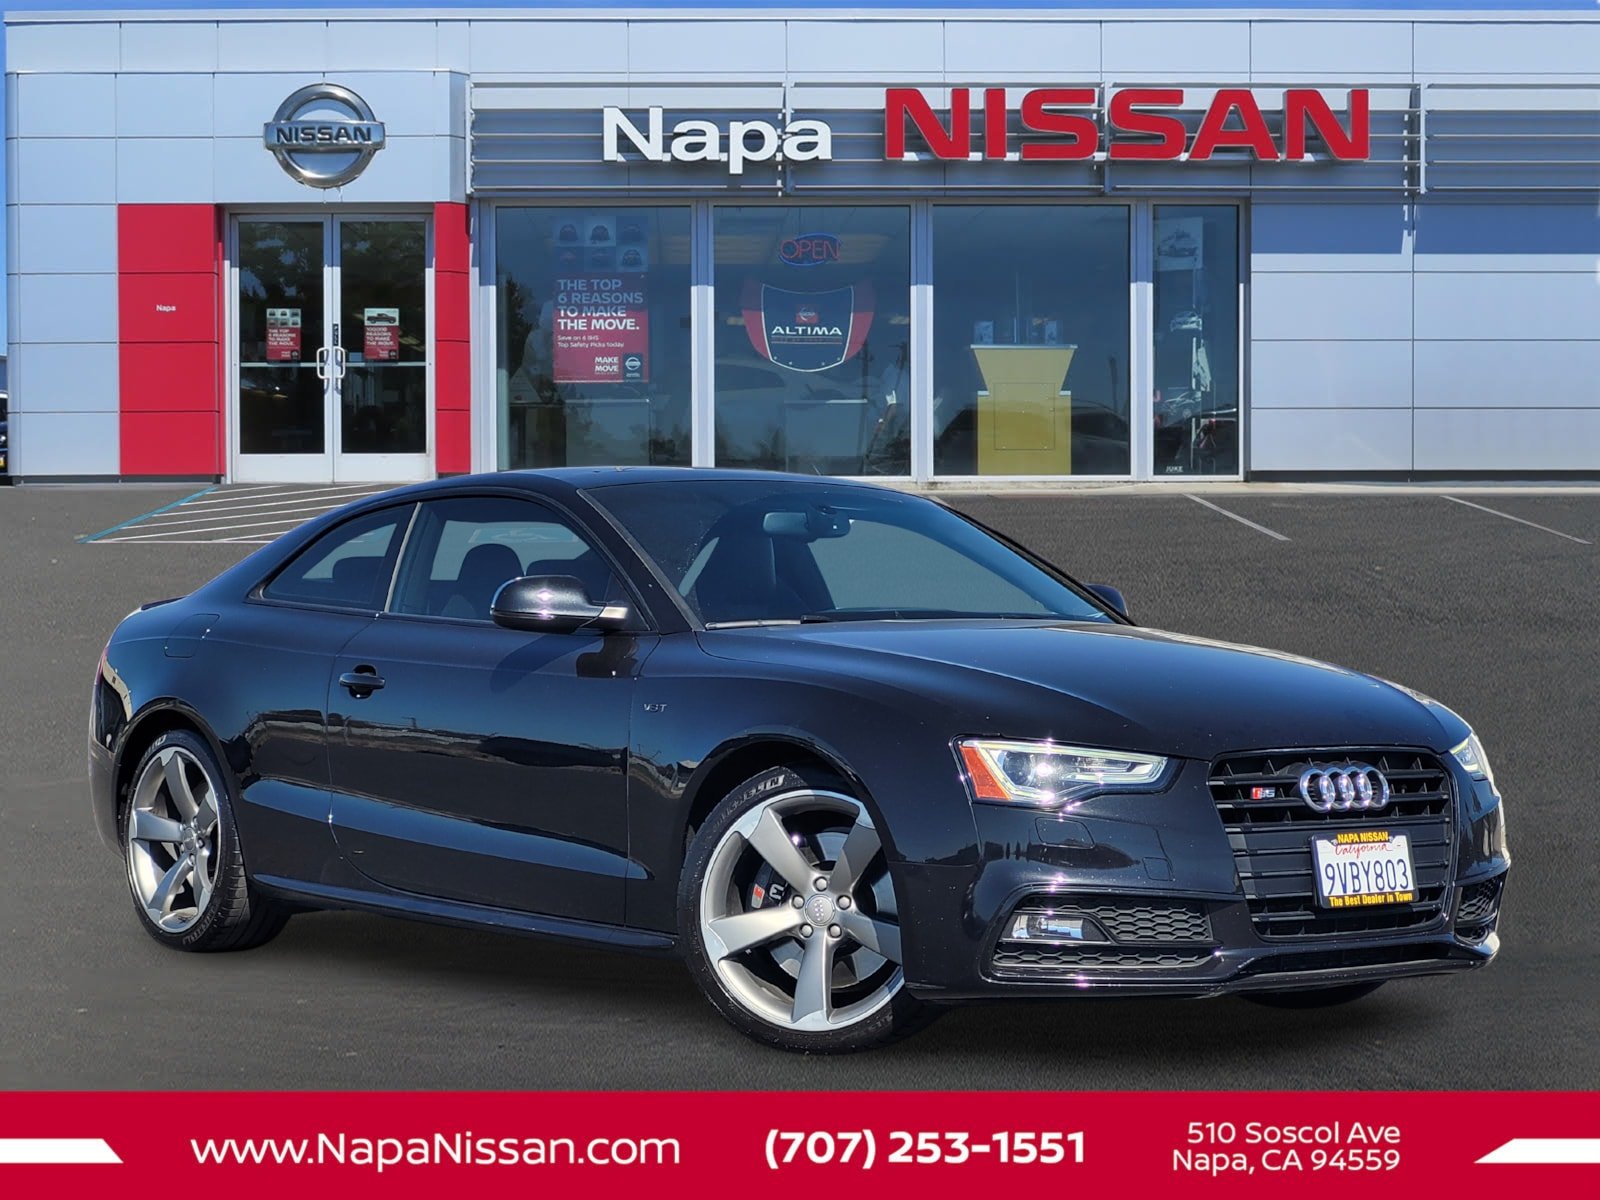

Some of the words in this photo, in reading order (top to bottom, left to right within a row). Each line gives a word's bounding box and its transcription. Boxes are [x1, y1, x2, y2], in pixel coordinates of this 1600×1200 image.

[276, 126, 372, 143] NISSAN
[603, 106, 833, 174] Napa
[885, 87, 1371, 161] NISSAN
[780, 238, 840, 260] OPEN
[557, 279, 587, 291] THE
[591, 279, 622, 291] TOP
[558, 292, 567, 304] 6
[571, 292, 644, 304] REASONS
[156, 304, 176, 312] Napa
[557, 305, 578, 317] TO
[582, 305, 627, 317] MAKE
[557, 318, 587, 331] THE
[591, 318, 640, 331] MOVE.
[771, 326, 842, 335] ALTIMA
[570, 341, 589, 349] Safety
[595, 356, 619, 364] MAKE
[595, 365, 619, 373] MOVE
[1337, 833, 1358, 844] NAPA
[1360, 831, 1389, 842] NISSAN
[1335, 843, 1393, 859] California
[1324, 858, 1408, 896] 9VBY803
[1329, 897, 1343, 907] The
[1345, 896, 1360, 905] Best
[1362, 895, 1385, 904] Dealer
[1395, 892, 1413, 902] Town
